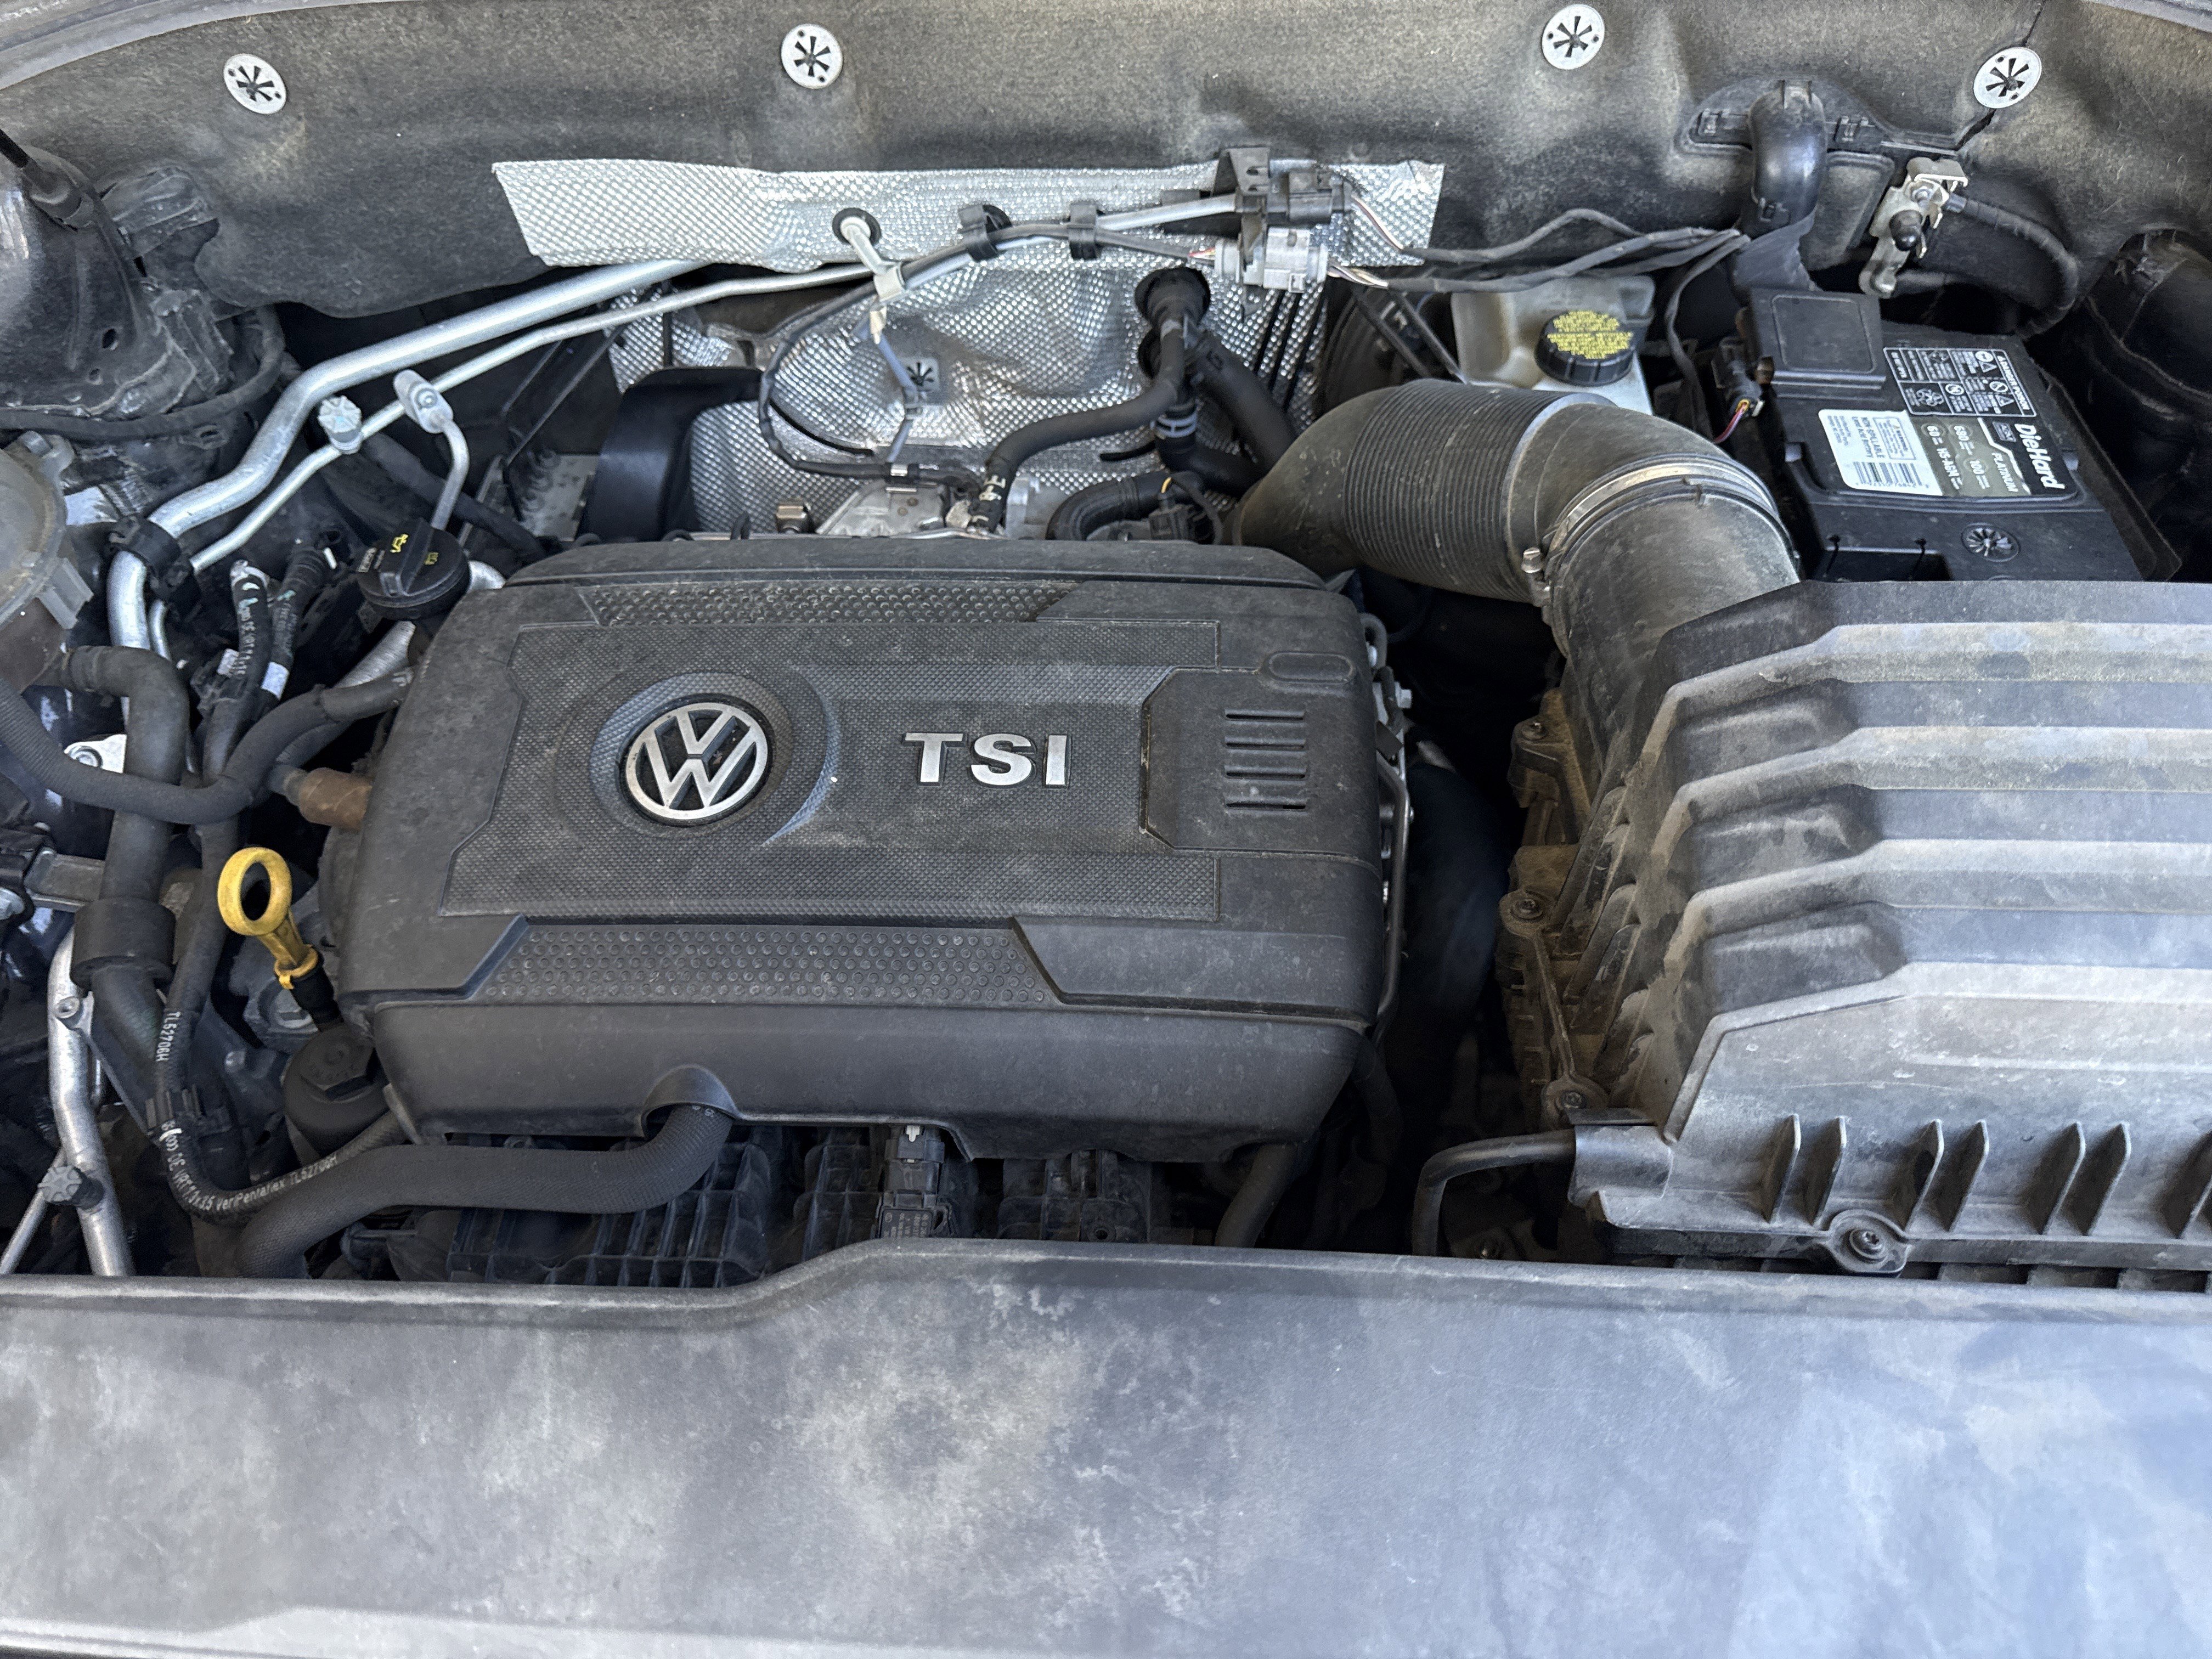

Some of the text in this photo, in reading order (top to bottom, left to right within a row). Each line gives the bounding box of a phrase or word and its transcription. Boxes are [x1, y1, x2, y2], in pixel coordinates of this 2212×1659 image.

[1927, 425, 1940, 437] 60
[1970, 459, 1984, 475] 100
[1991, 452, 2018, 492] PLATINUM
[2015, 424, 2066, 489] DieHard
[905, 731, 1071, 787] TSI
[155, 1011, 181, 1062] TL52706H
